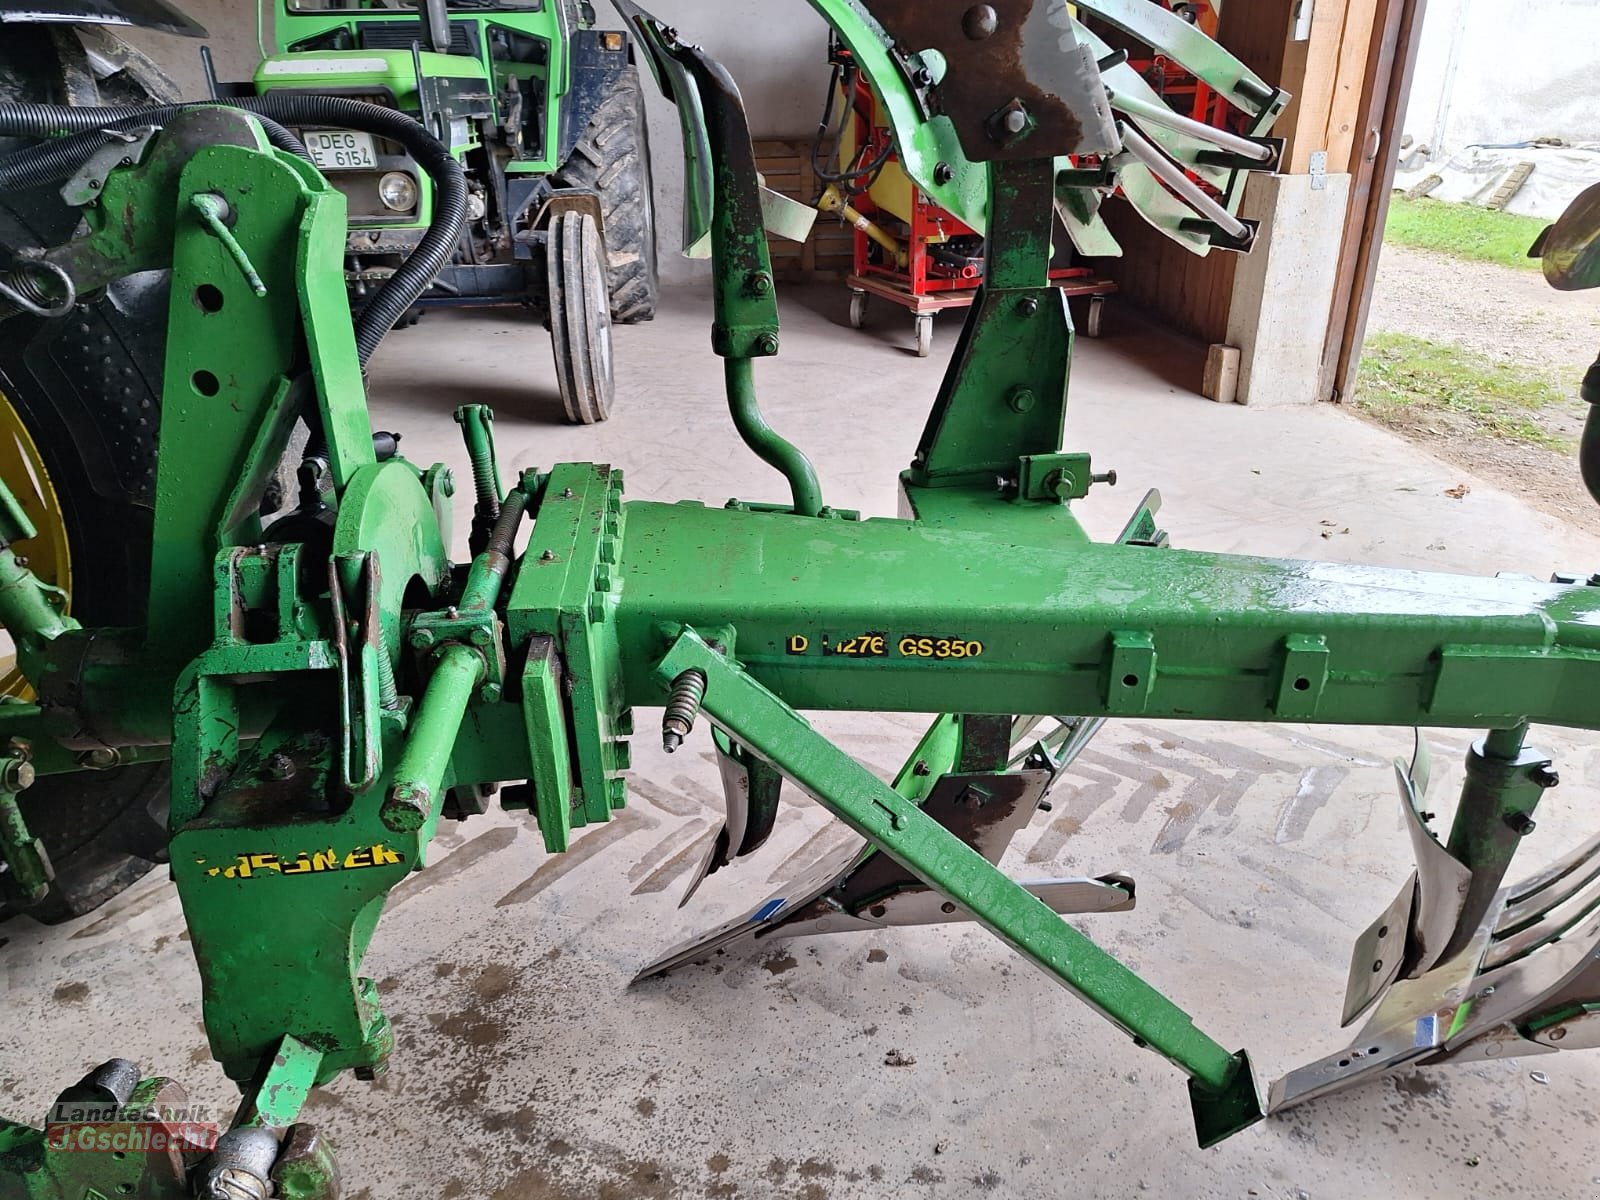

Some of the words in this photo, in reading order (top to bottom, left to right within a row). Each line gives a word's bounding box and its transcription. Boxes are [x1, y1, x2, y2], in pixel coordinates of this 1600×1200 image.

[319, 134, 355, 149] DEG
[335, 151, 371, 166] 6154
[791, 635, 808, 652] D
